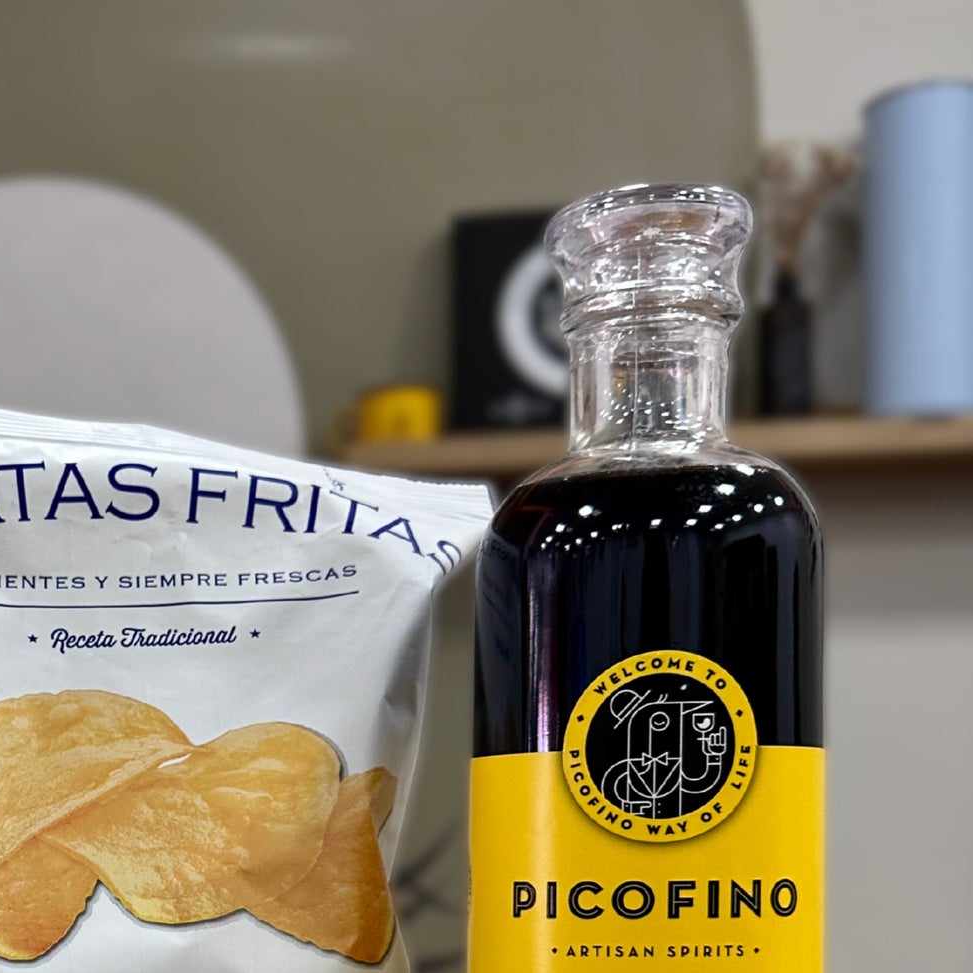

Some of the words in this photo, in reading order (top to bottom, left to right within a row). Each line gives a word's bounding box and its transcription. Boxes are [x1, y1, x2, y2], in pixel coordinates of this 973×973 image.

[185, 467, 463, 575] FRITAS
[95, 576, 109, 589] Y
[118, 574, 228, 589] SIEMPRE
[238, 565, 358, 587] FRESCAS
[50, 628, 117, 654] Receta
[120, 626, 237, 649] Tradicional
[593, 657, 695, 696] WELCOME
[706, 668, 727, 690] TO
[568, 749, 633, 830] PICOFINO
[646, 821, 688, 836] WAY
[700, 802, 724, 823] OF
[731, 745, 752, 790] LIFE
[512, 878, 798, 920] PICOFINO
[566, 945, 655, 958] ARTISAN
[667, 945, 745, 958] SPIRITS
